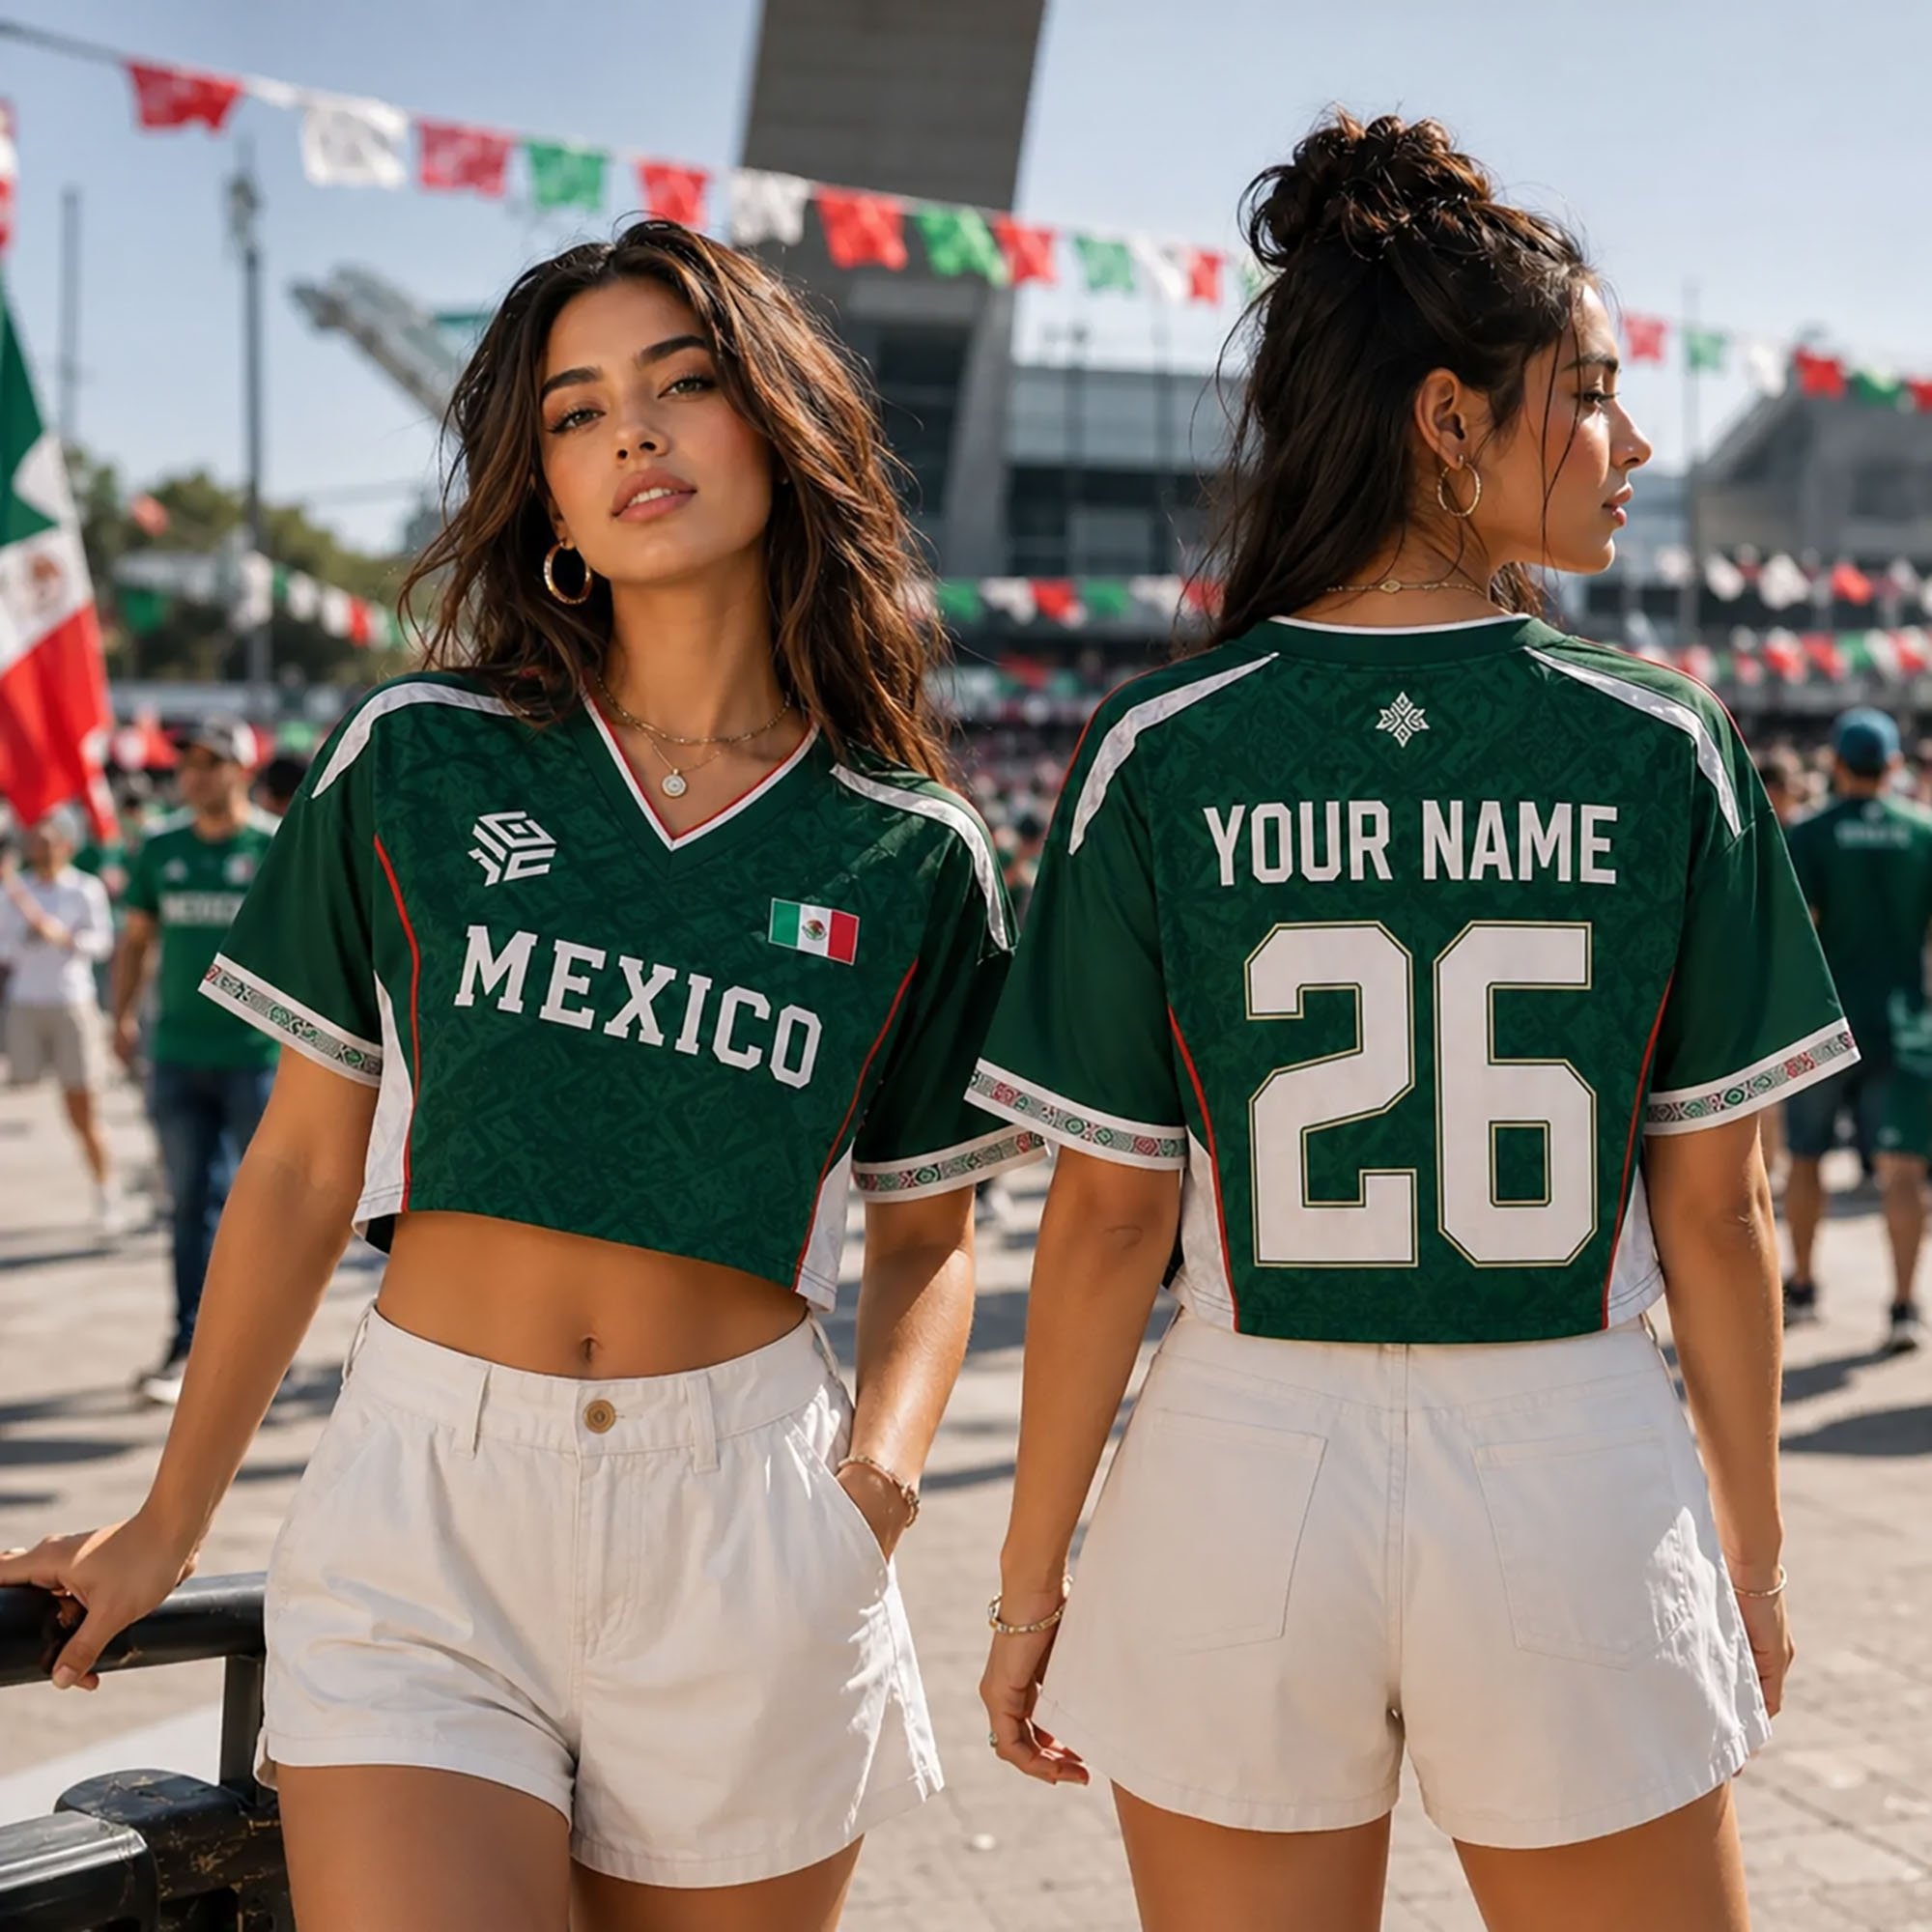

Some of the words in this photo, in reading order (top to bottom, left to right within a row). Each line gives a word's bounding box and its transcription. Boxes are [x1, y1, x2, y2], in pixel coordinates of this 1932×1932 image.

[1203, 800, 1393, 887] YOUR
[1422, 800, 1618, 885] NAME
[453, 924, 823, 1089] MEXICO
[1244, 920, 1599, 1267] 26
